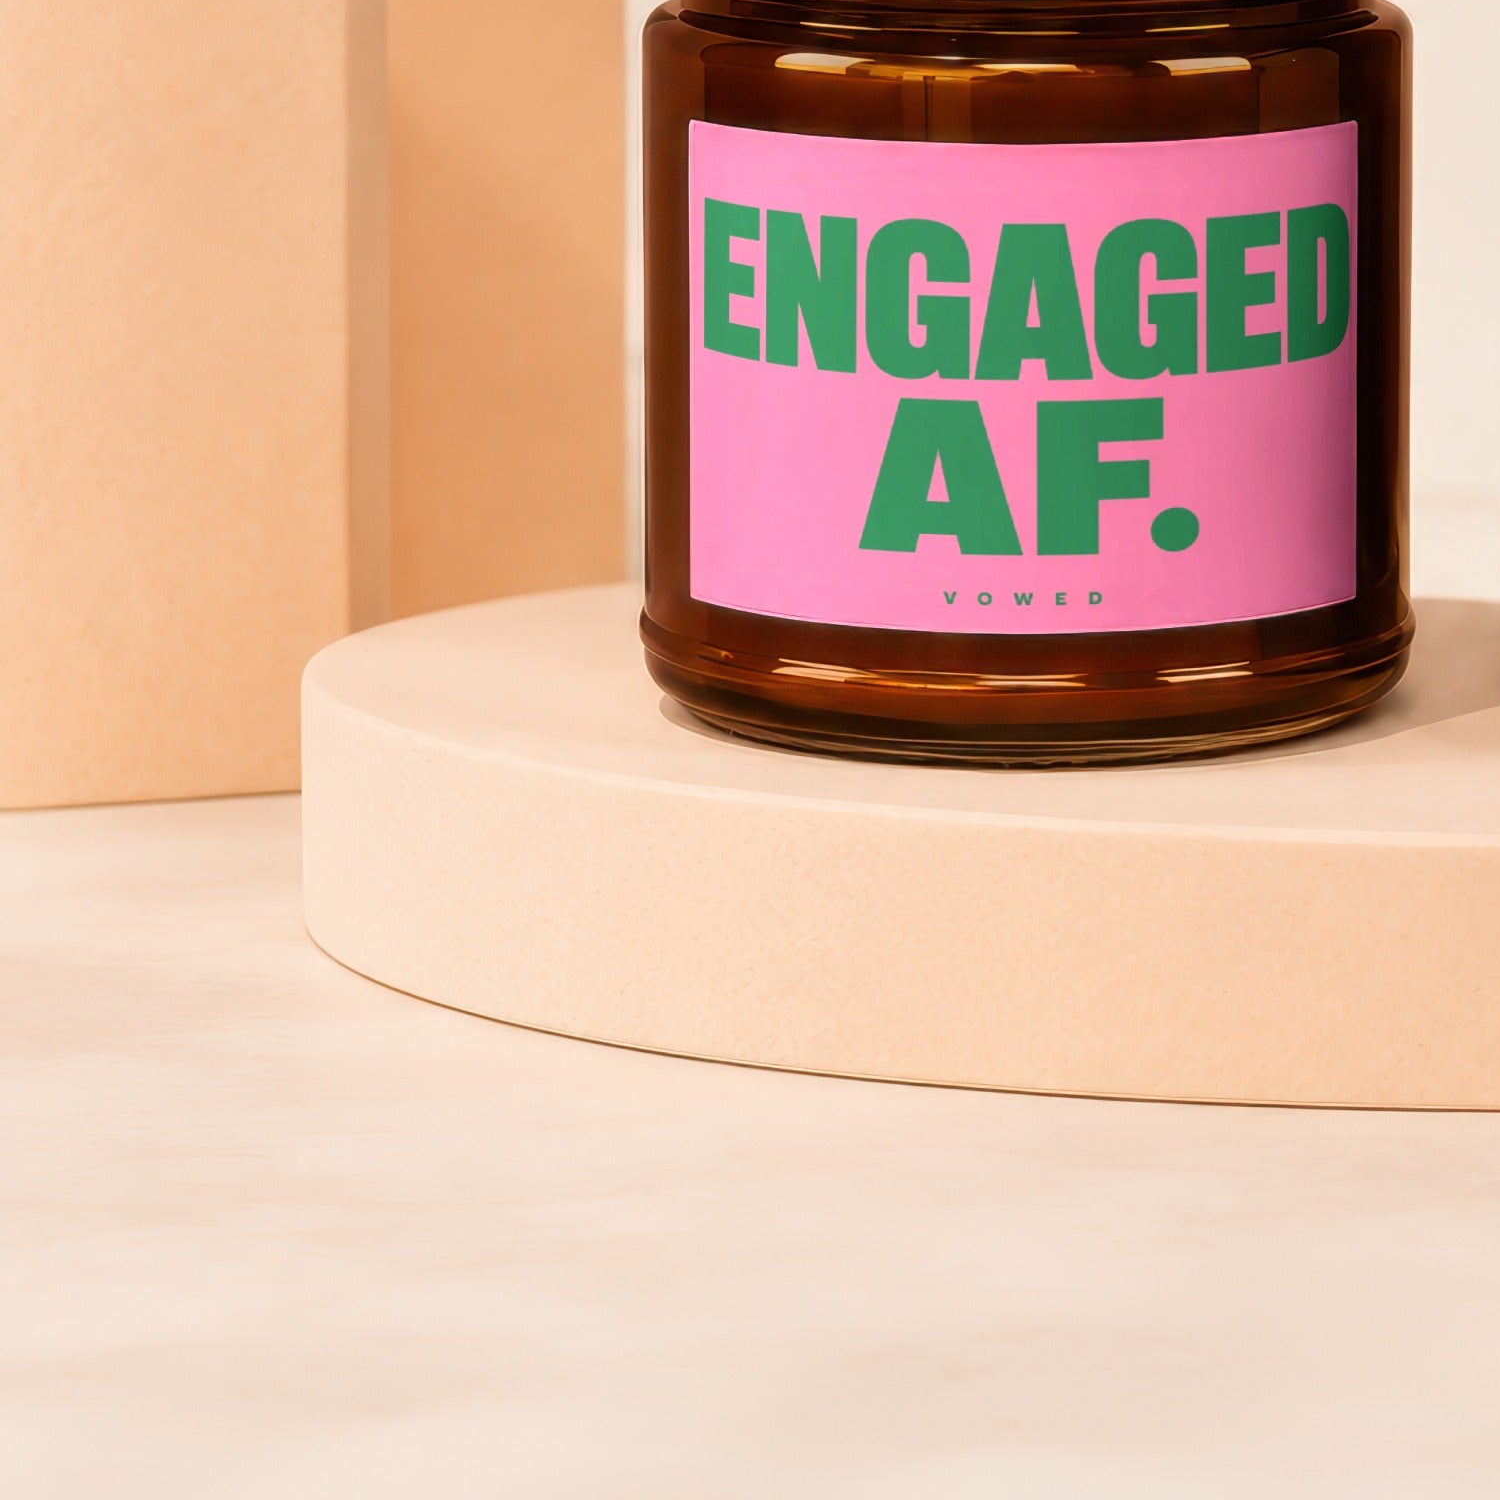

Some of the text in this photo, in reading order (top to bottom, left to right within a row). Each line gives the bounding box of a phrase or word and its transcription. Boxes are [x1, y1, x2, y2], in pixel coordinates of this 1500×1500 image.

[703, 197, 1350, 381] ENGAGED
[859, 397, 1199, 556] AF.
[943, 591, 1103, 606] VOWED
